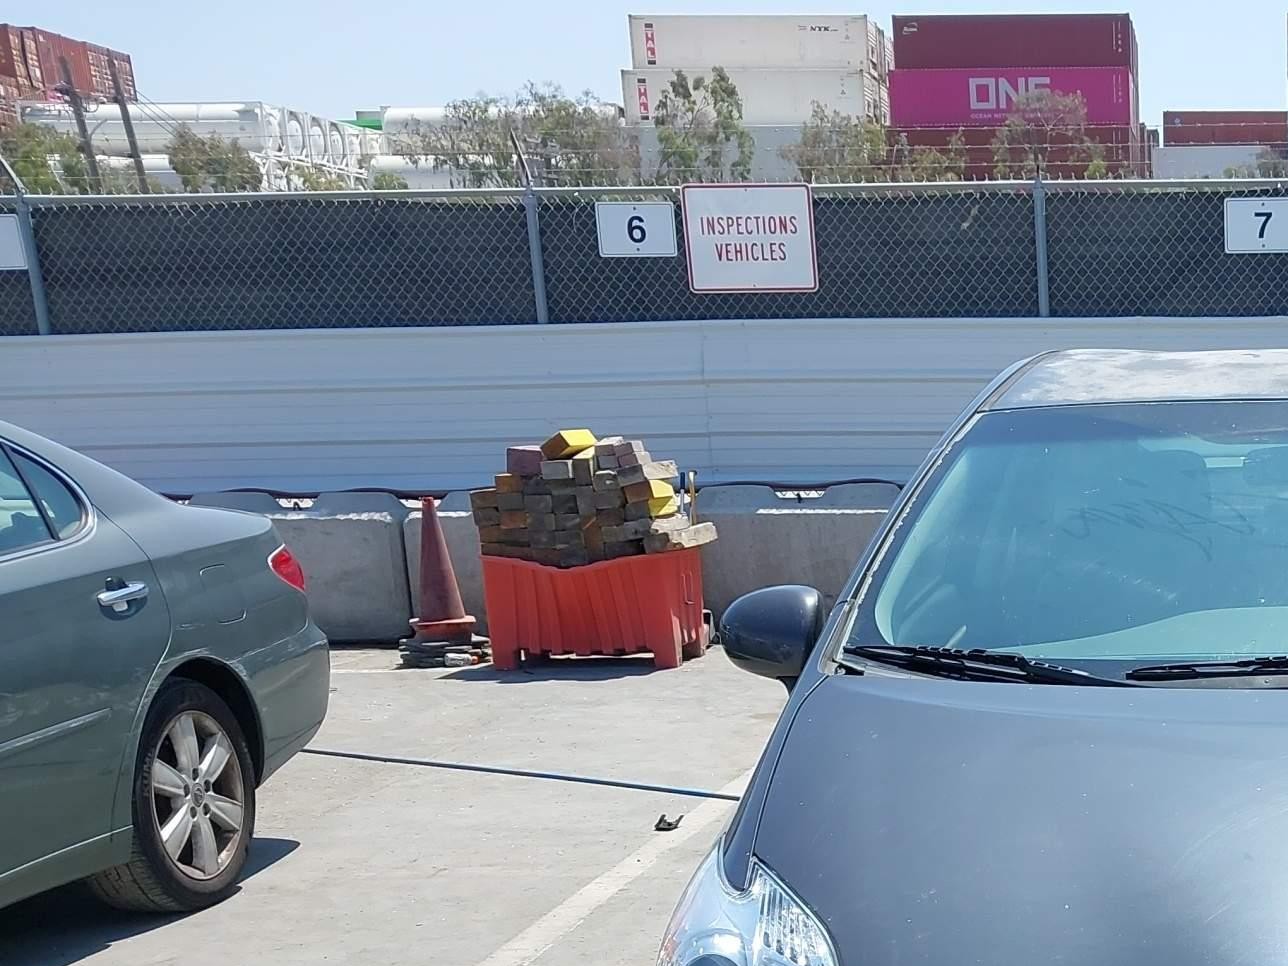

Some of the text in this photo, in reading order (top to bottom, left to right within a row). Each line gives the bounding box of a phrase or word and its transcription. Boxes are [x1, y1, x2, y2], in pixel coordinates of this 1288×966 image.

[645, 31, 656, 58] TAL
[638, 87, 648, 113] TAL
[627, 215, 647, 243] 6
[699, 215, 798, 236] INSPECTIONS
[1254, 212, 1273, 239] 7
[714, 242, 787, 262] VEHICLES
